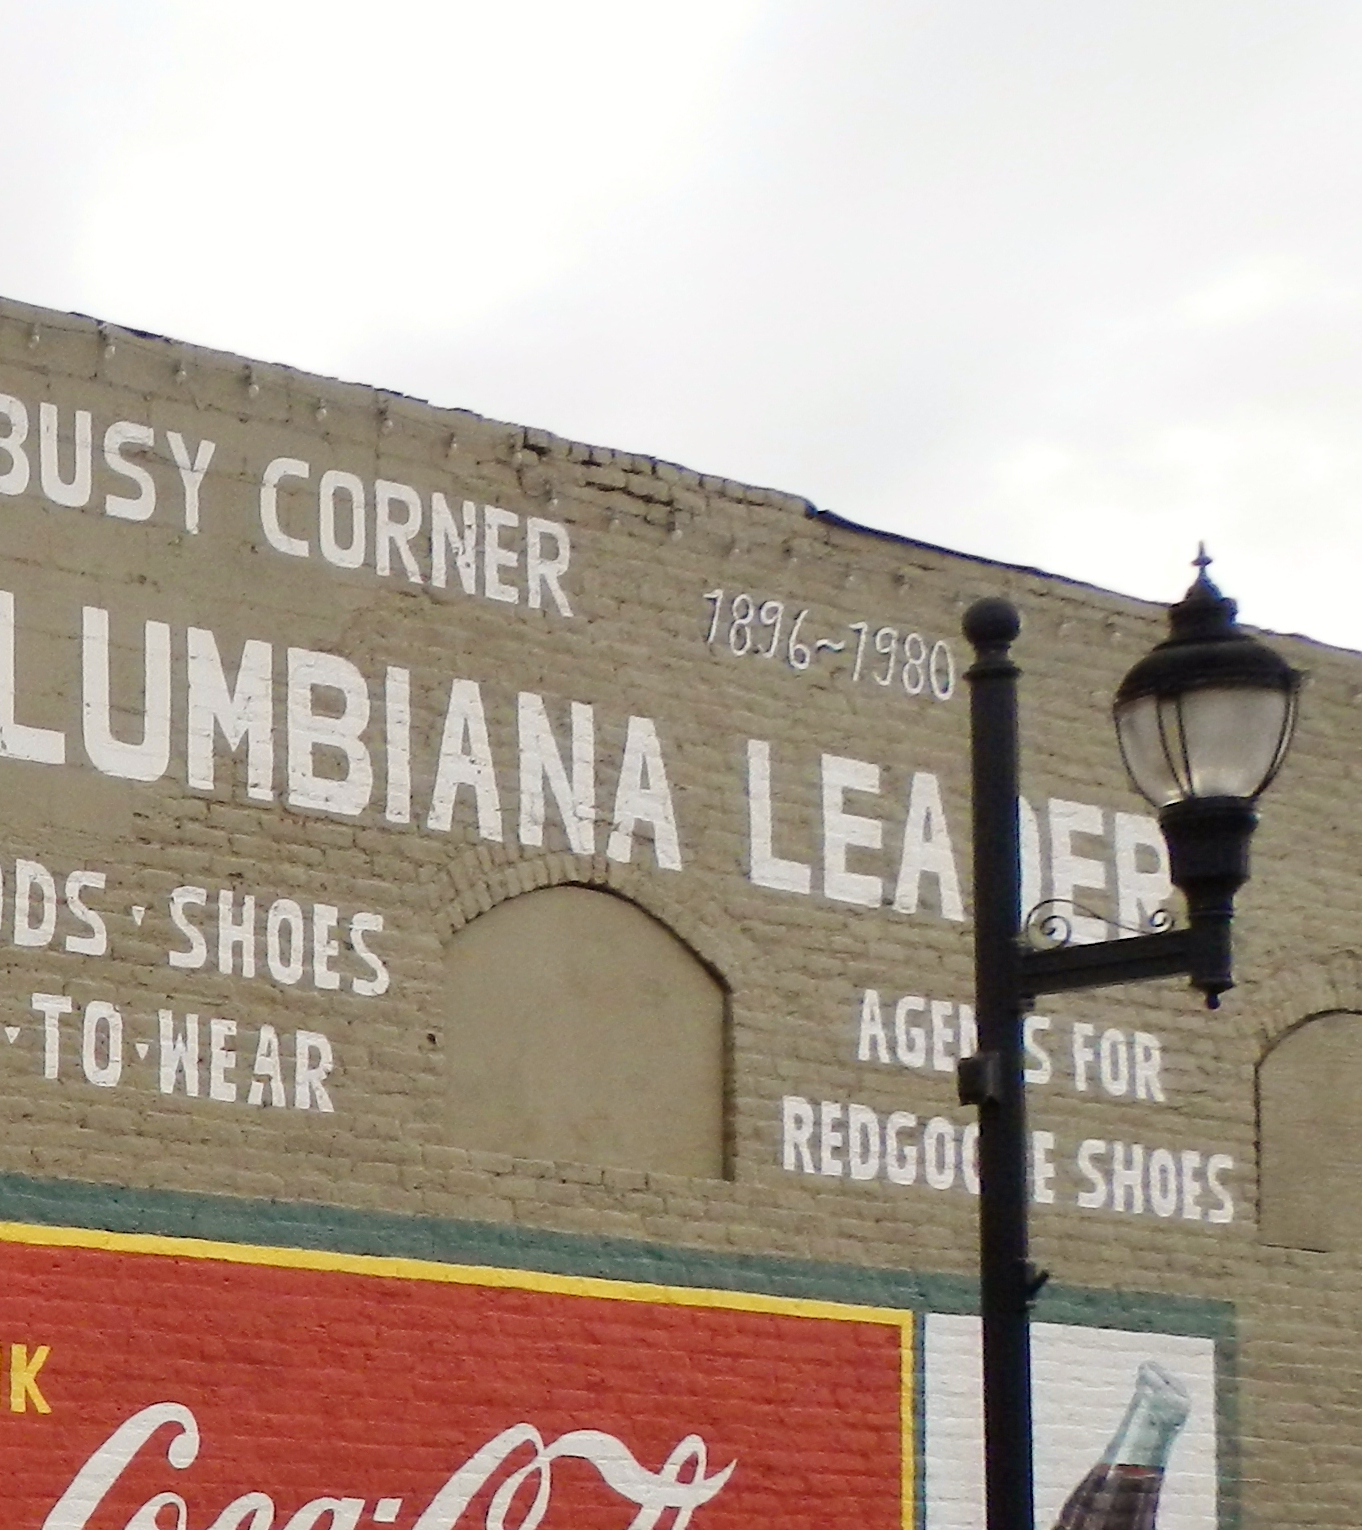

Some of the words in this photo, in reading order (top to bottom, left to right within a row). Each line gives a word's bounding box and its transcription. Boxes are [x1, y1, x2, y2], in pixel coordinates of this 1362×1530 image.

[261, 456, 575, 618] CORNER
[168, 884, 391, 997] SHOES
[857, 988, 1052, 1086] AGENS
[1073, 1021, 1168, 1102] FOR
[781, 1094, 1056, 1205] REDGOOE
[1077, 1137, 1236, 1225] SHOES
